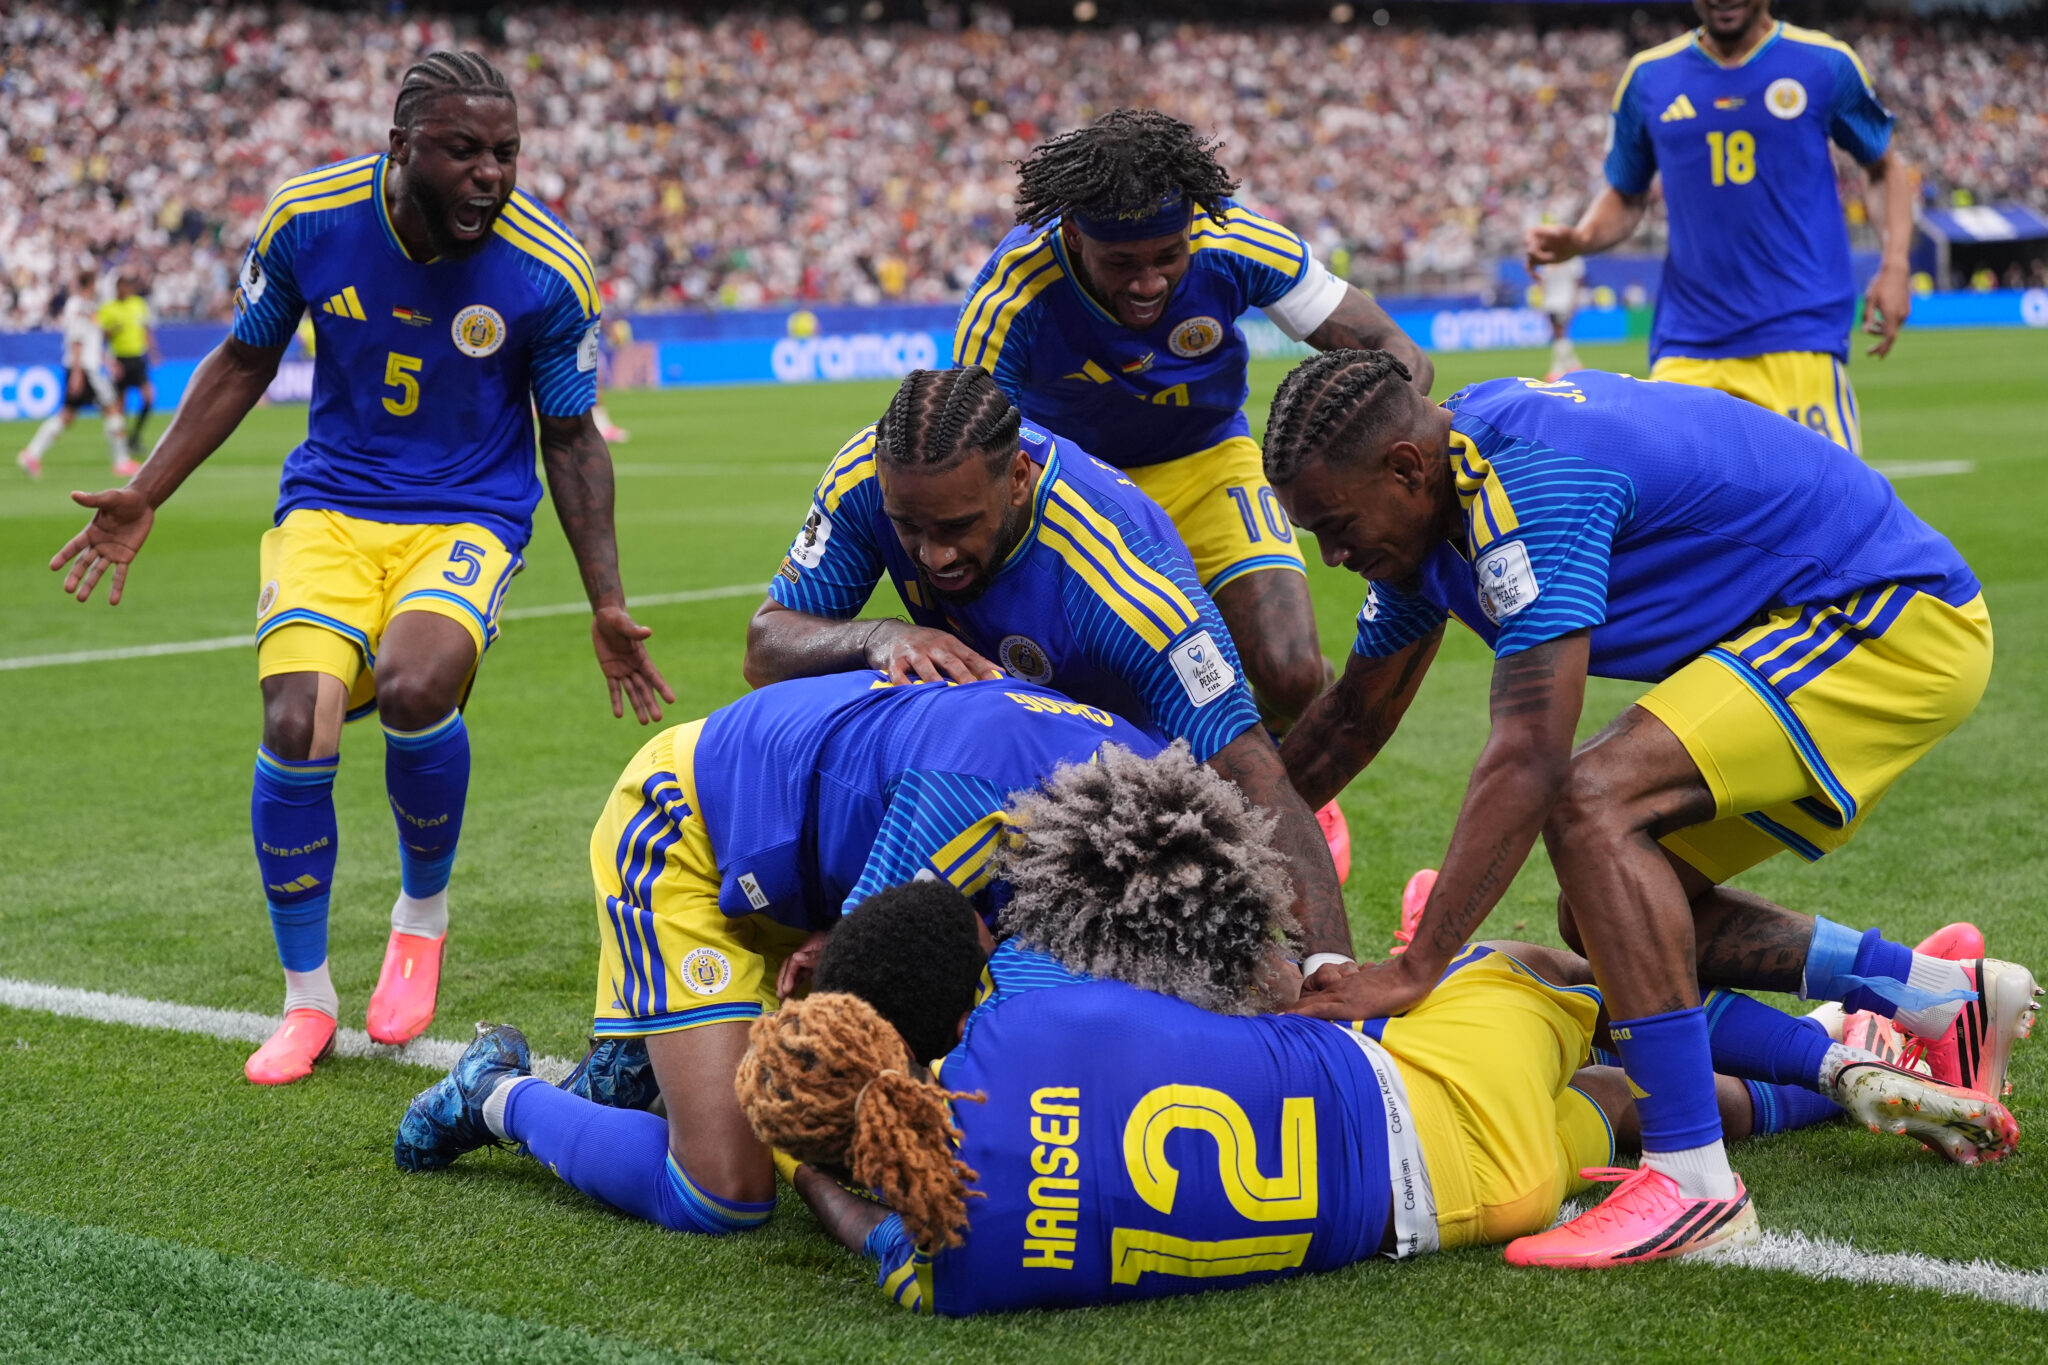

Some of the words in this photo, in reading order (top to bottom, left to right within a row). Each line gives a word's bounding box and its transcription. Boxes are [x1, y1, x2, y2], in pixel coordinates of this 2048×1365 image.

[1706, 130, 1756, 187] 18
[771, 332, 938, 383] aramco
[382, 351, 423, 417] 5
[1226, 486, 1292, 544] 10
[442, 540, 486, 587] 5
[1497, 585, 1520, 604] PEACE
[1504, 600, 1518, 609] FIFA
[1199, 669, 1221, 688] PEACE
[1207, 682, 1221, 692] FIFA
[1376, 1068, 1391, 1095] Klein
[1387, 1097, 1402, 1134] Calvin
[1022, 1086, 1080, 1270] HANSEN
[1111, 1083, 1319, 1286] 12
